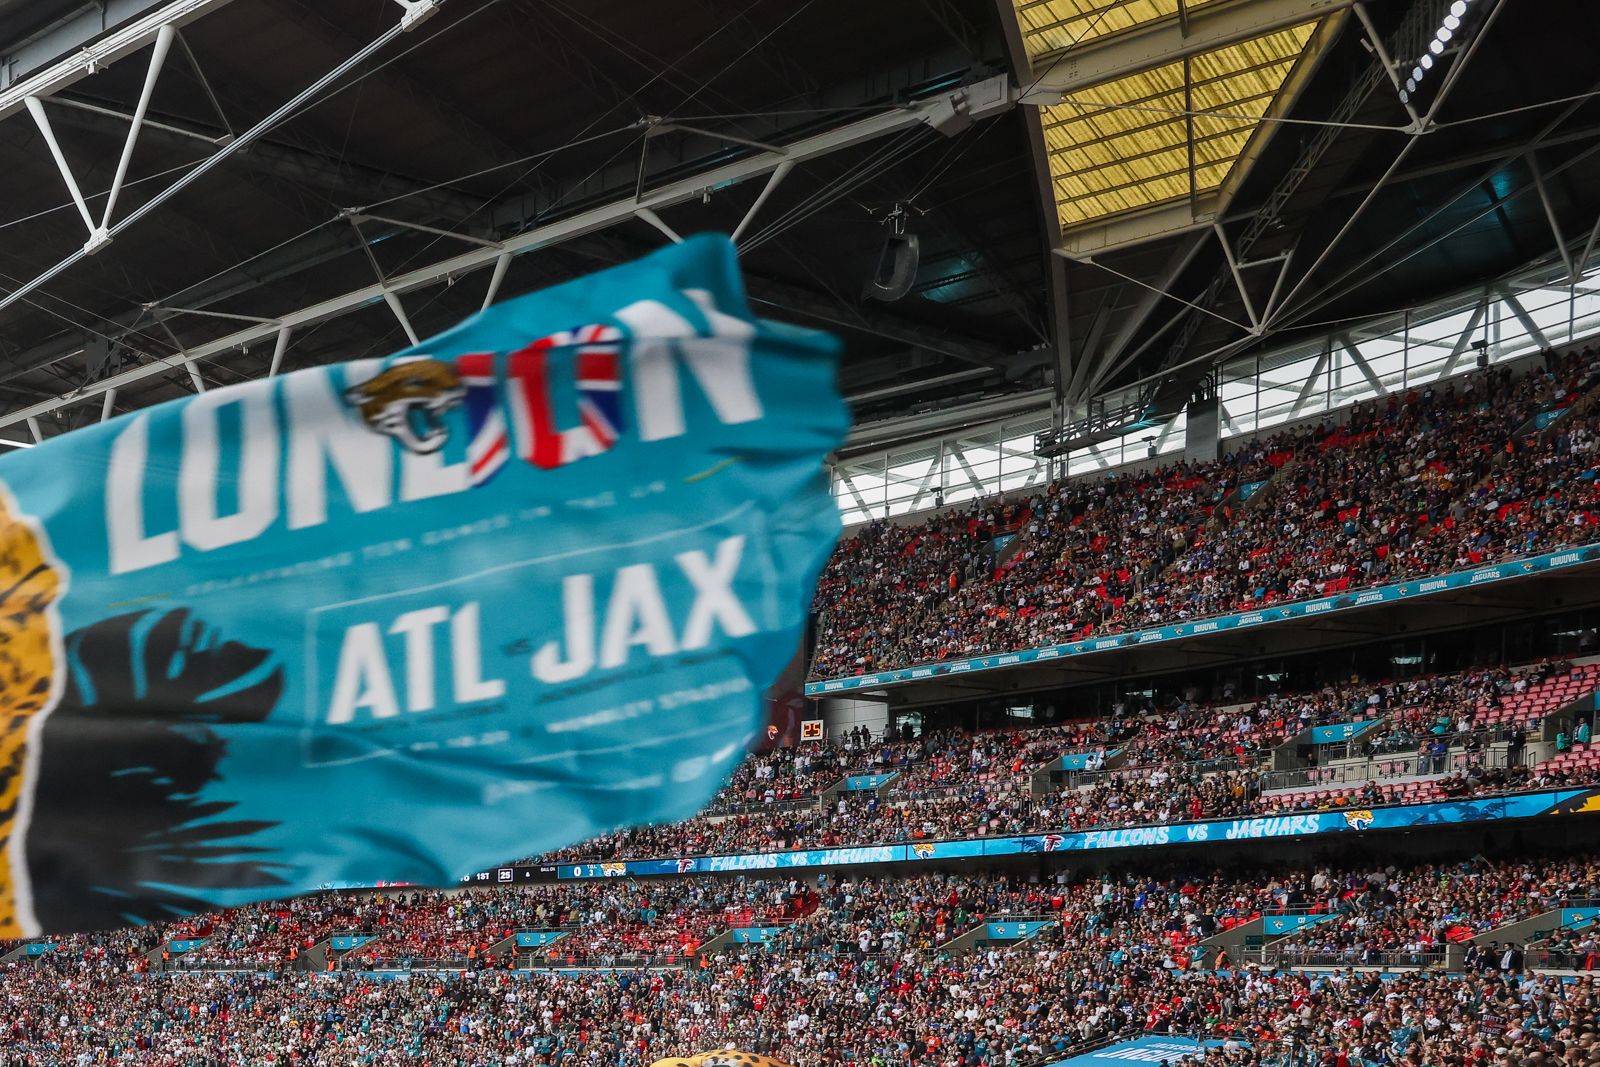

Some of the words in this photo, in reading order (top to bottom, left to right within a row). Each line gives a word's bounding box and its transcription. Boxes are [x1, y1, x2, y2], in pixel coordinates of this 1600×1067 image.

[106, 288, 763, 576] LONDON
[1470, 571, 1500, 583] JAGUARS
[327, 599, 506, 725] ATL
[531, 536, 756, 685] JAX
[803, 722, 821, 737] 25
[1084, 826, 1169, 849] FALCONS
[1187, 825, 1208, 840] VS
[1225, 813, 1320, 839] JAGUARS
[500, 871, 511, 880] 25
